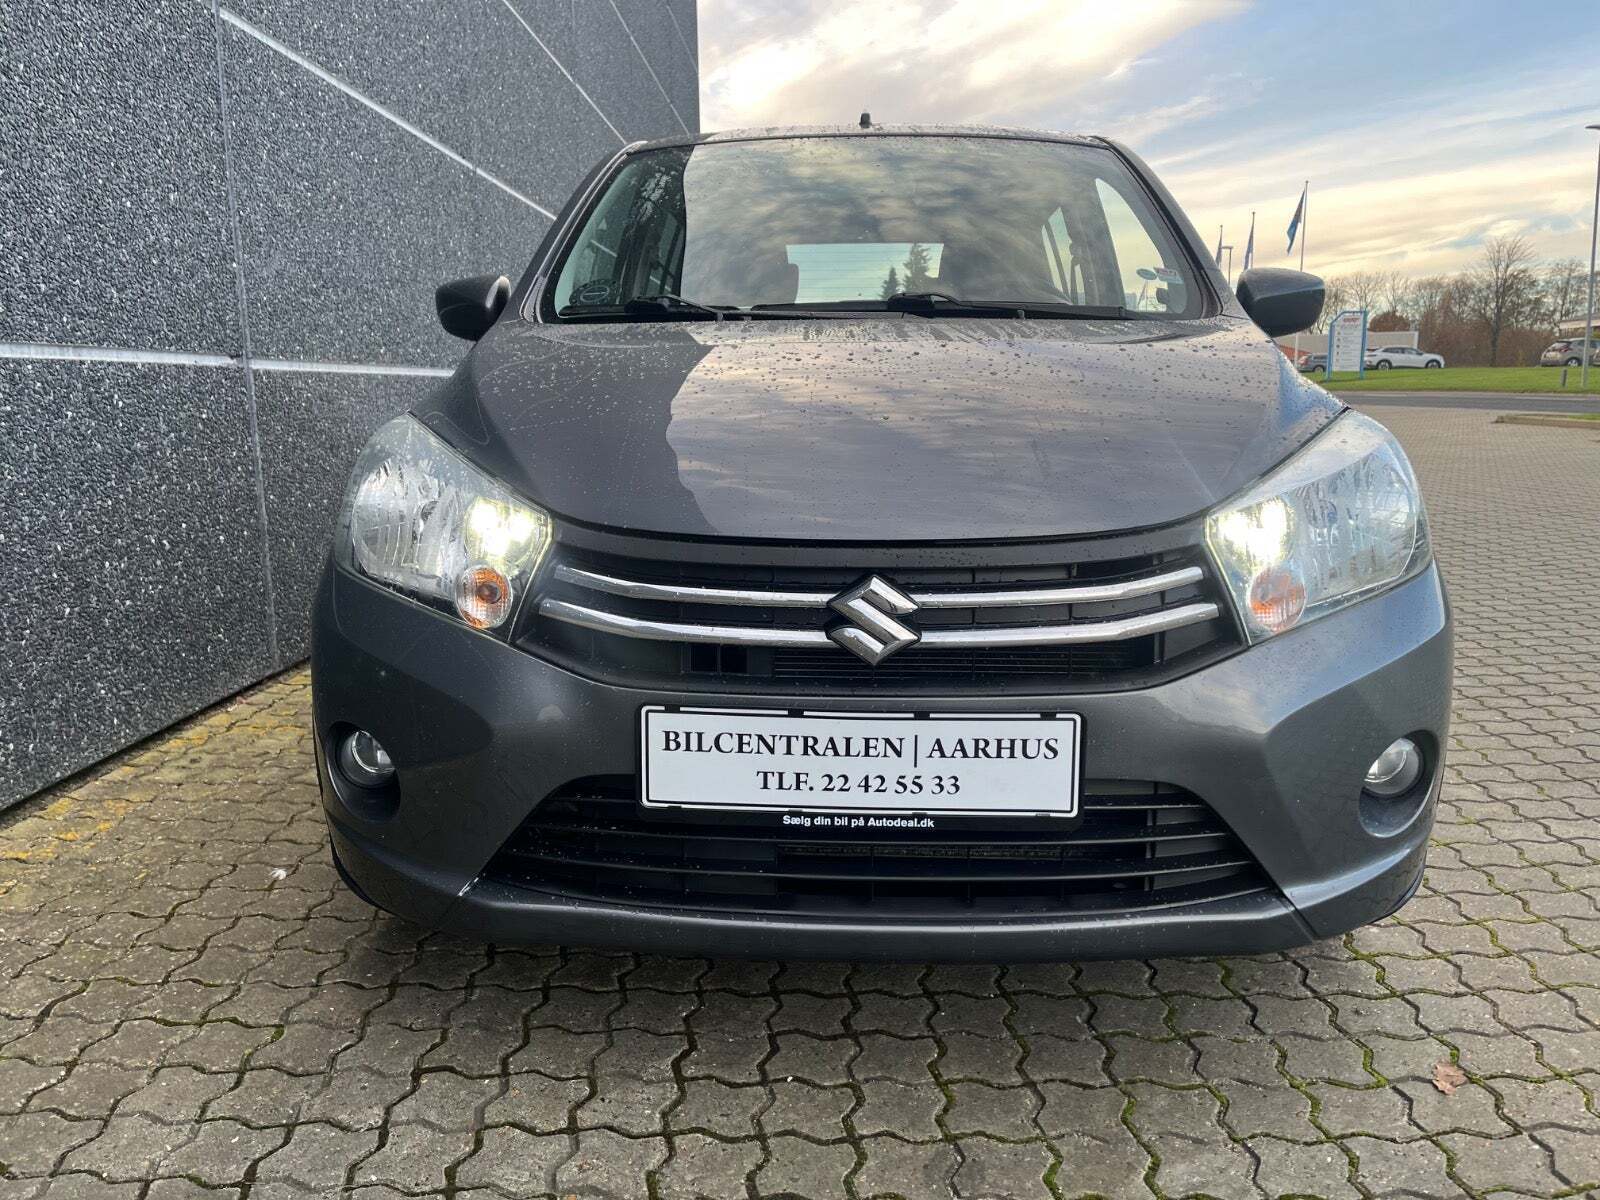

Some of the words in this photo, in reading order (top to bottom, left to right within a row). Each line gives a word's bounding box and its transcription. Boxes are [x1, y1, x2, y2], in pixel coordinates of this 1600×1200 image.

[662, 730, 905, 758] BILCENTRALEN
[926, 737, 1059, 760] AARHUS
[756, 771, 814, 792] TLF.
[821, 774, 851, 792] 22
[857, 774, 888, 793] 42
[894, 775, 924, 795] 55
[931, 775, 961, 795] 33
[782, 815, 811, 827] Sælg
[813, 816, 831, 826] din
[834, 816, 849, 826] bil
[850, 816, 865, 828] på
[867, 817, 935, 828] Autodeal.dk
